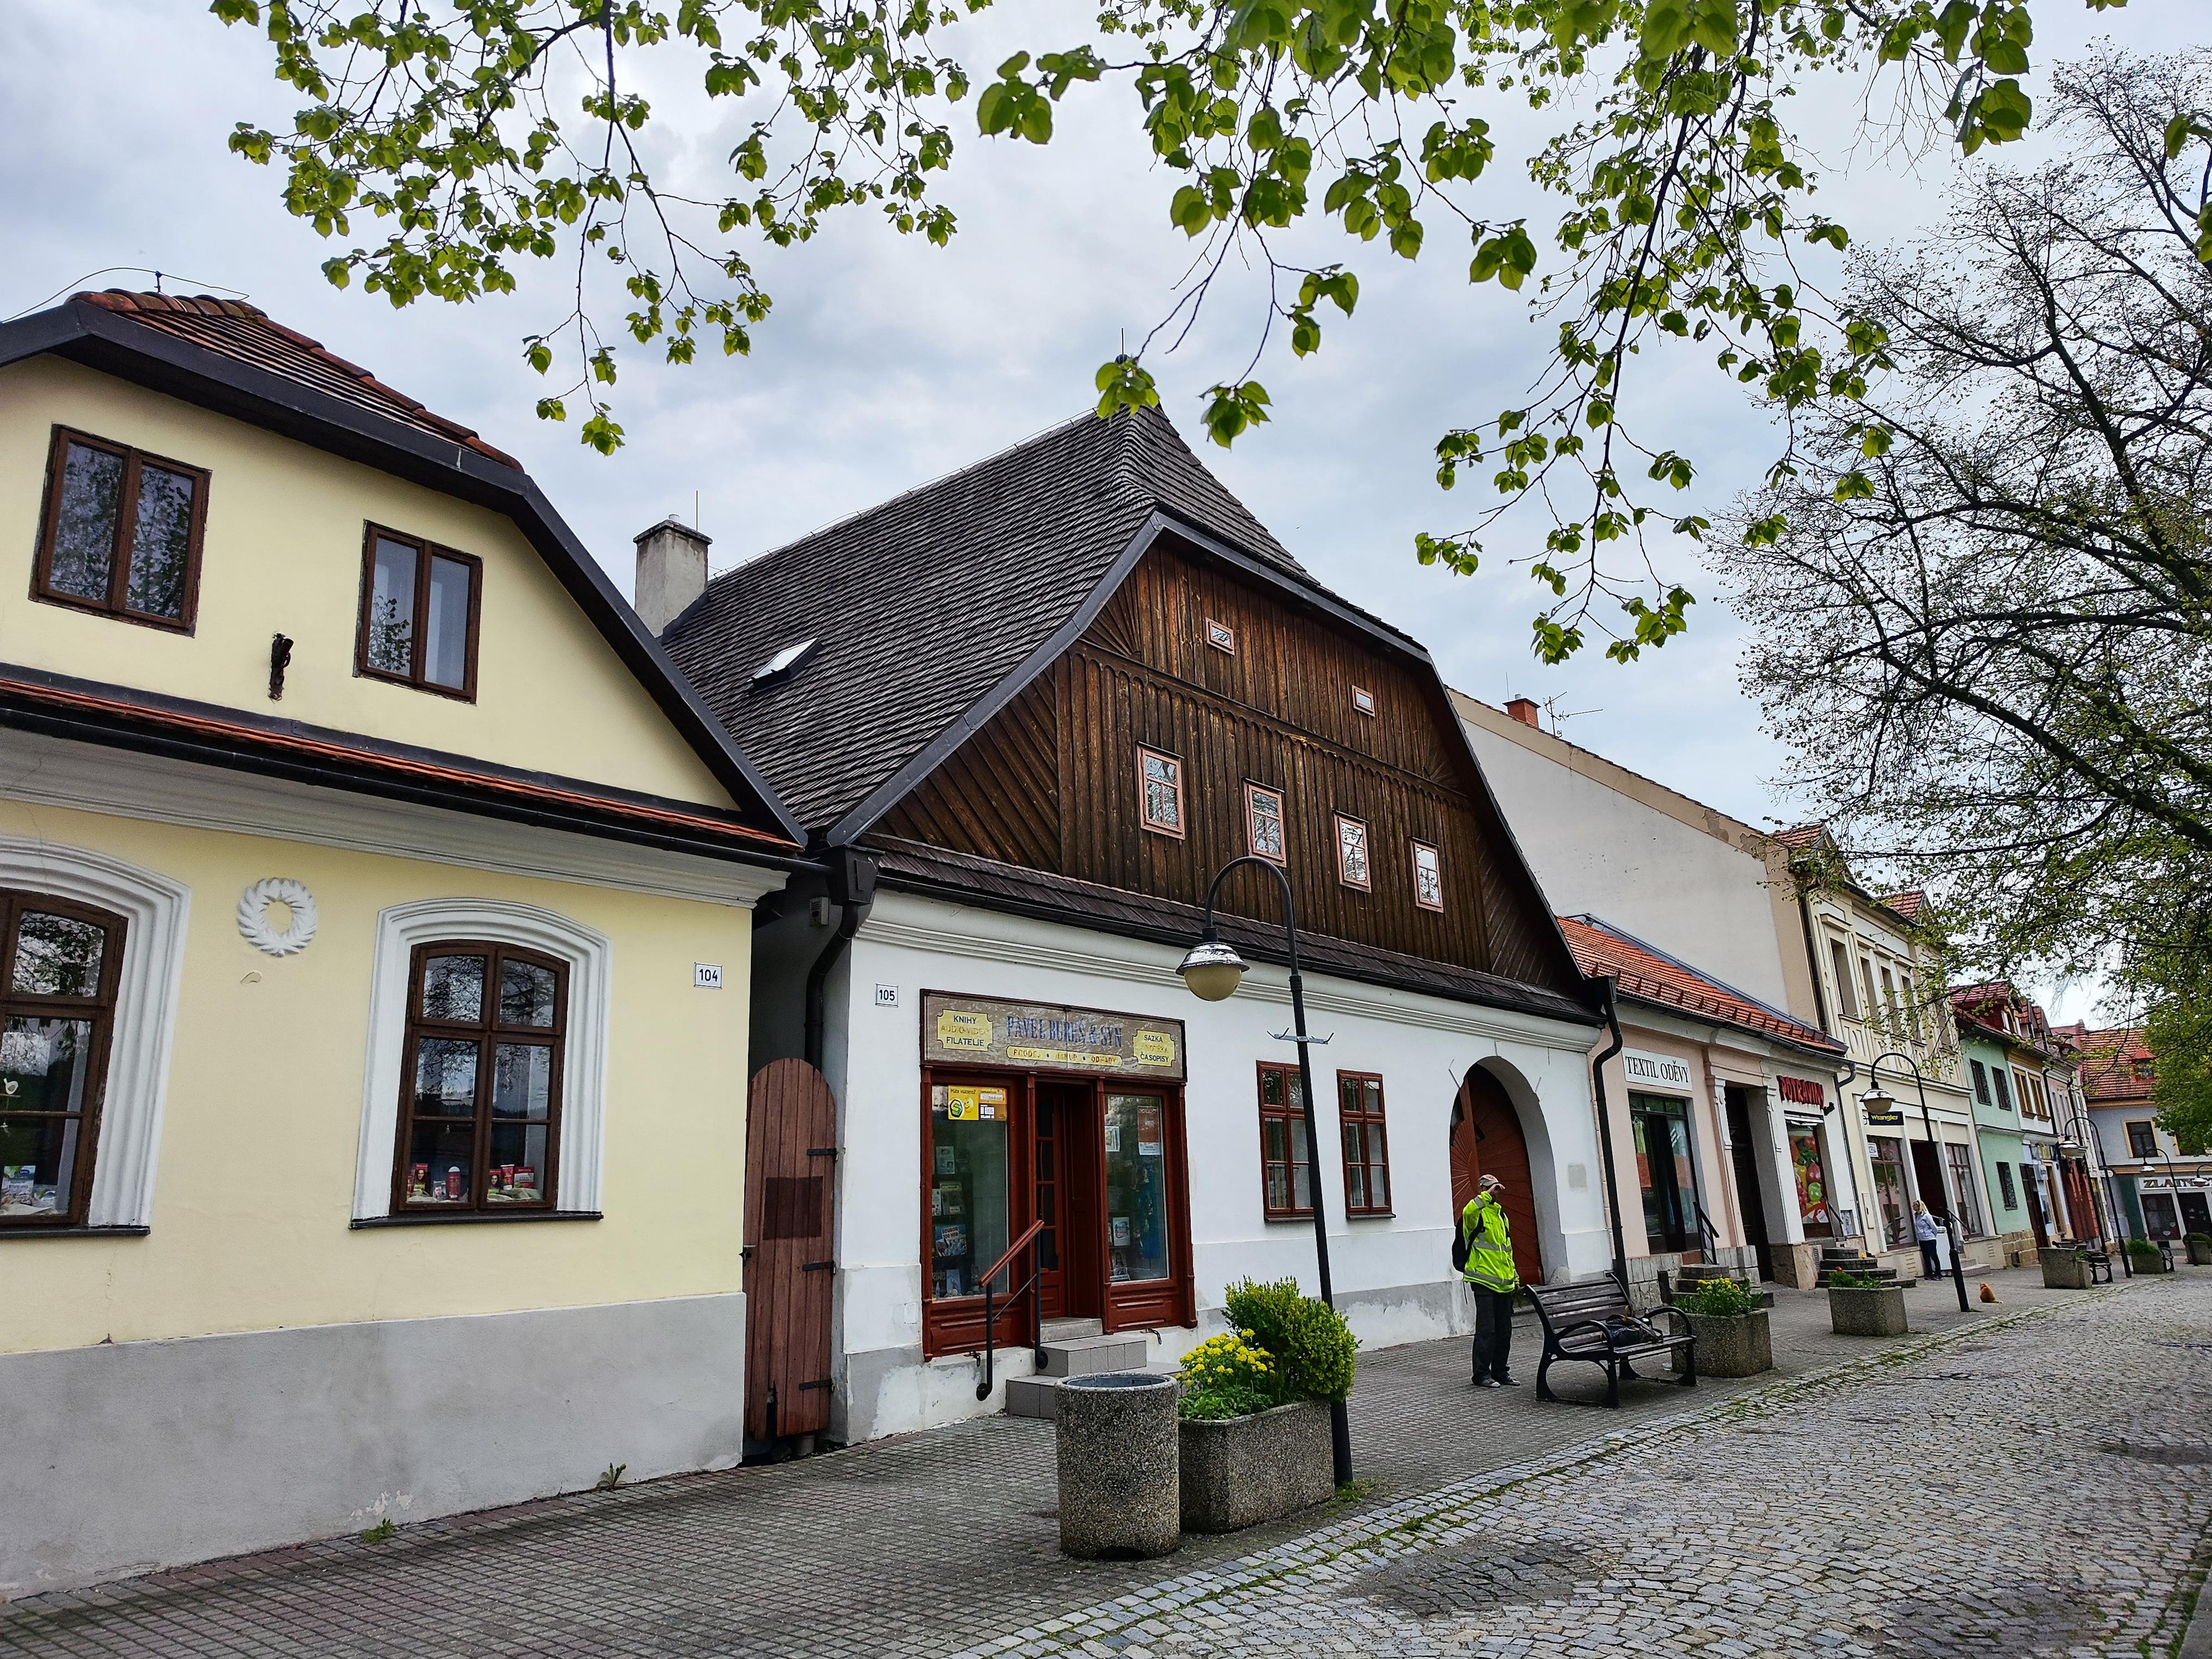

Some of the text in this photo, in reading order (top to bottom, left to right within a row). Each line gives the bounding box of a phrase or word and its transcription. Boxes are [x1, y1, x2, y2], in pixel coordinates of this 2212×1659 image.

[699, 968, 718, 982] 104
[879, 989, 895, 1001] 105
[953, 1015, 977, 1024] KNIHY
[1006, 1015, 1046, 1040] PAVEL
[946, 1036, 984, 1046] FILATELIE
[1144, 1034, 1164, 1043] SAZKA
[1140, 1051, 1169, 1062] ČASOPISY
[1625, 1056, 1689, 1083] TEXTIL ODĚVY
[1776, 1076, 1824, 1110] POTRAVINY
